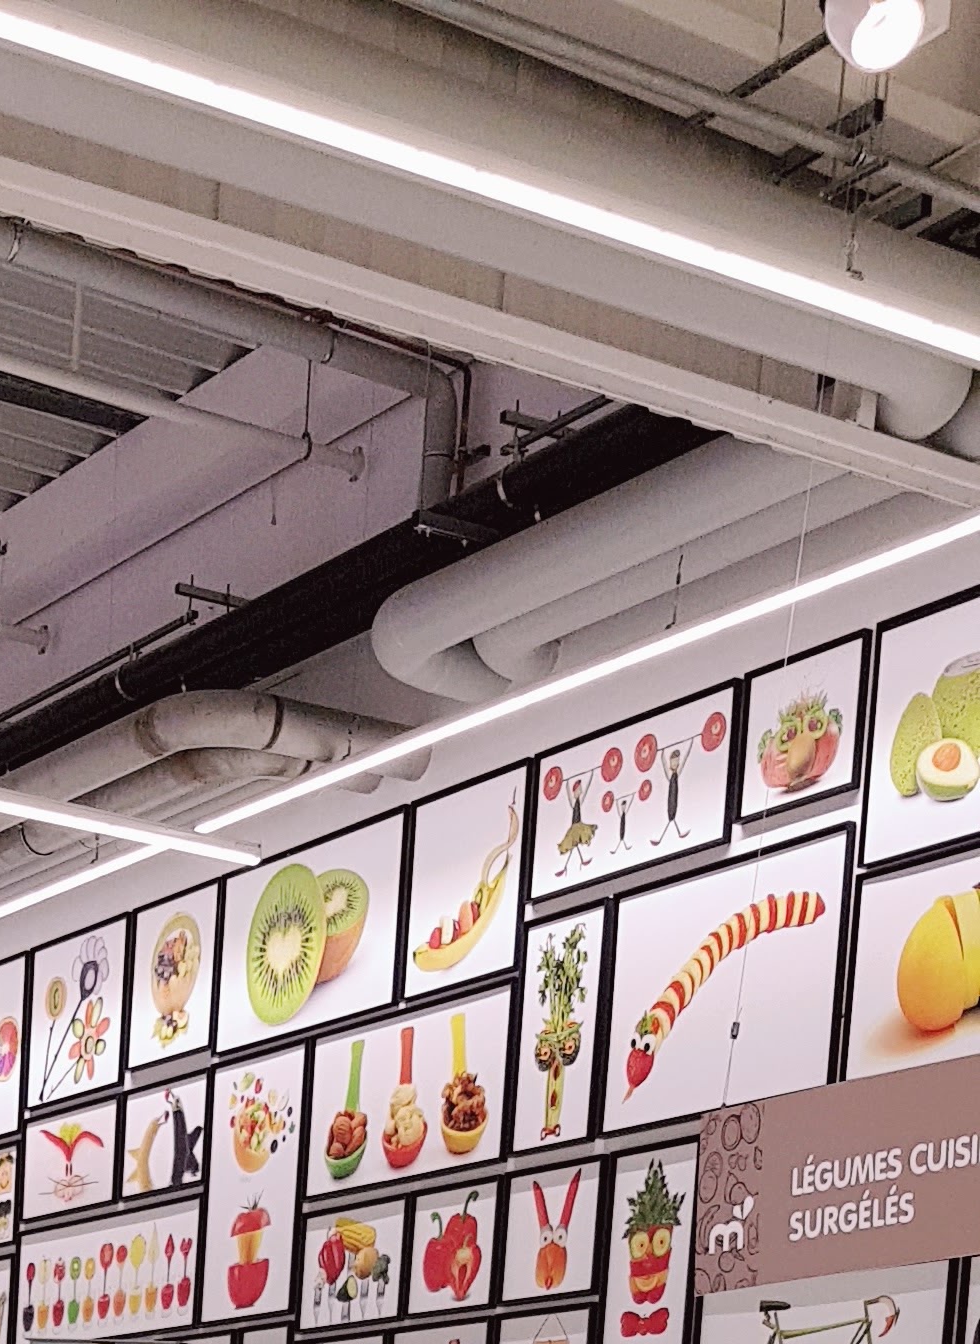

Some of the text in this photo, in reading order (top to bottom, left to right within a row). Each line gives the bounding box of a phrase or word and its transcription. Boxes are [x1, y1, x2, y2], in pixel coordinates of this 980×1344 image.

[791, 1134, 980, 1196] LÉGUMES CUISI
[789, 1185, 914, 1242] SURGÉLÉS
